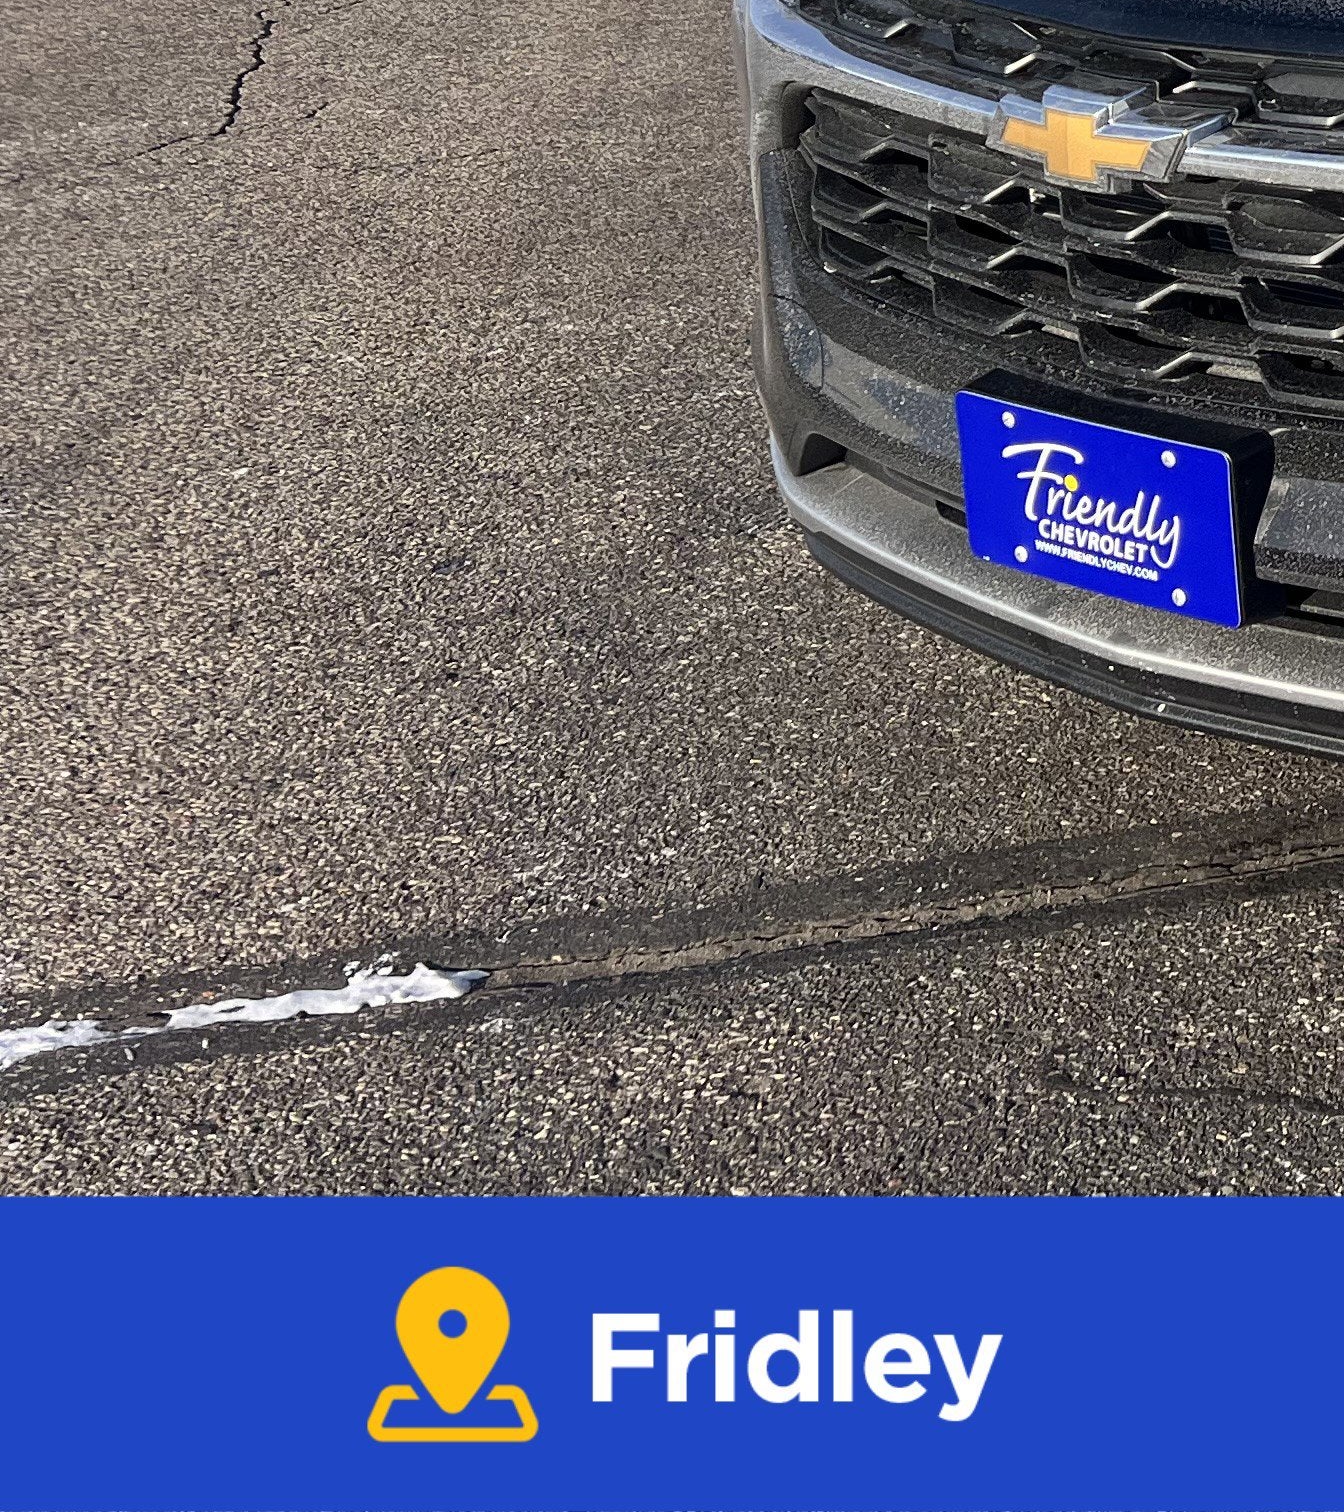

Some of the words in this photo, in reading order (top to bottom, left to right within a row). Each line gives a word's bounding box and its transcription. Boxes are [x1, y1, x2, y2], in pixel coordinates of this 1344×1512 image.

[1002, 442, 1180, 569] Friendly
[1034, 539, 1159, 582] WWW.FRIENDLYCHEV.COM
[1038, 518, 1149, 563] CHEVROLET
